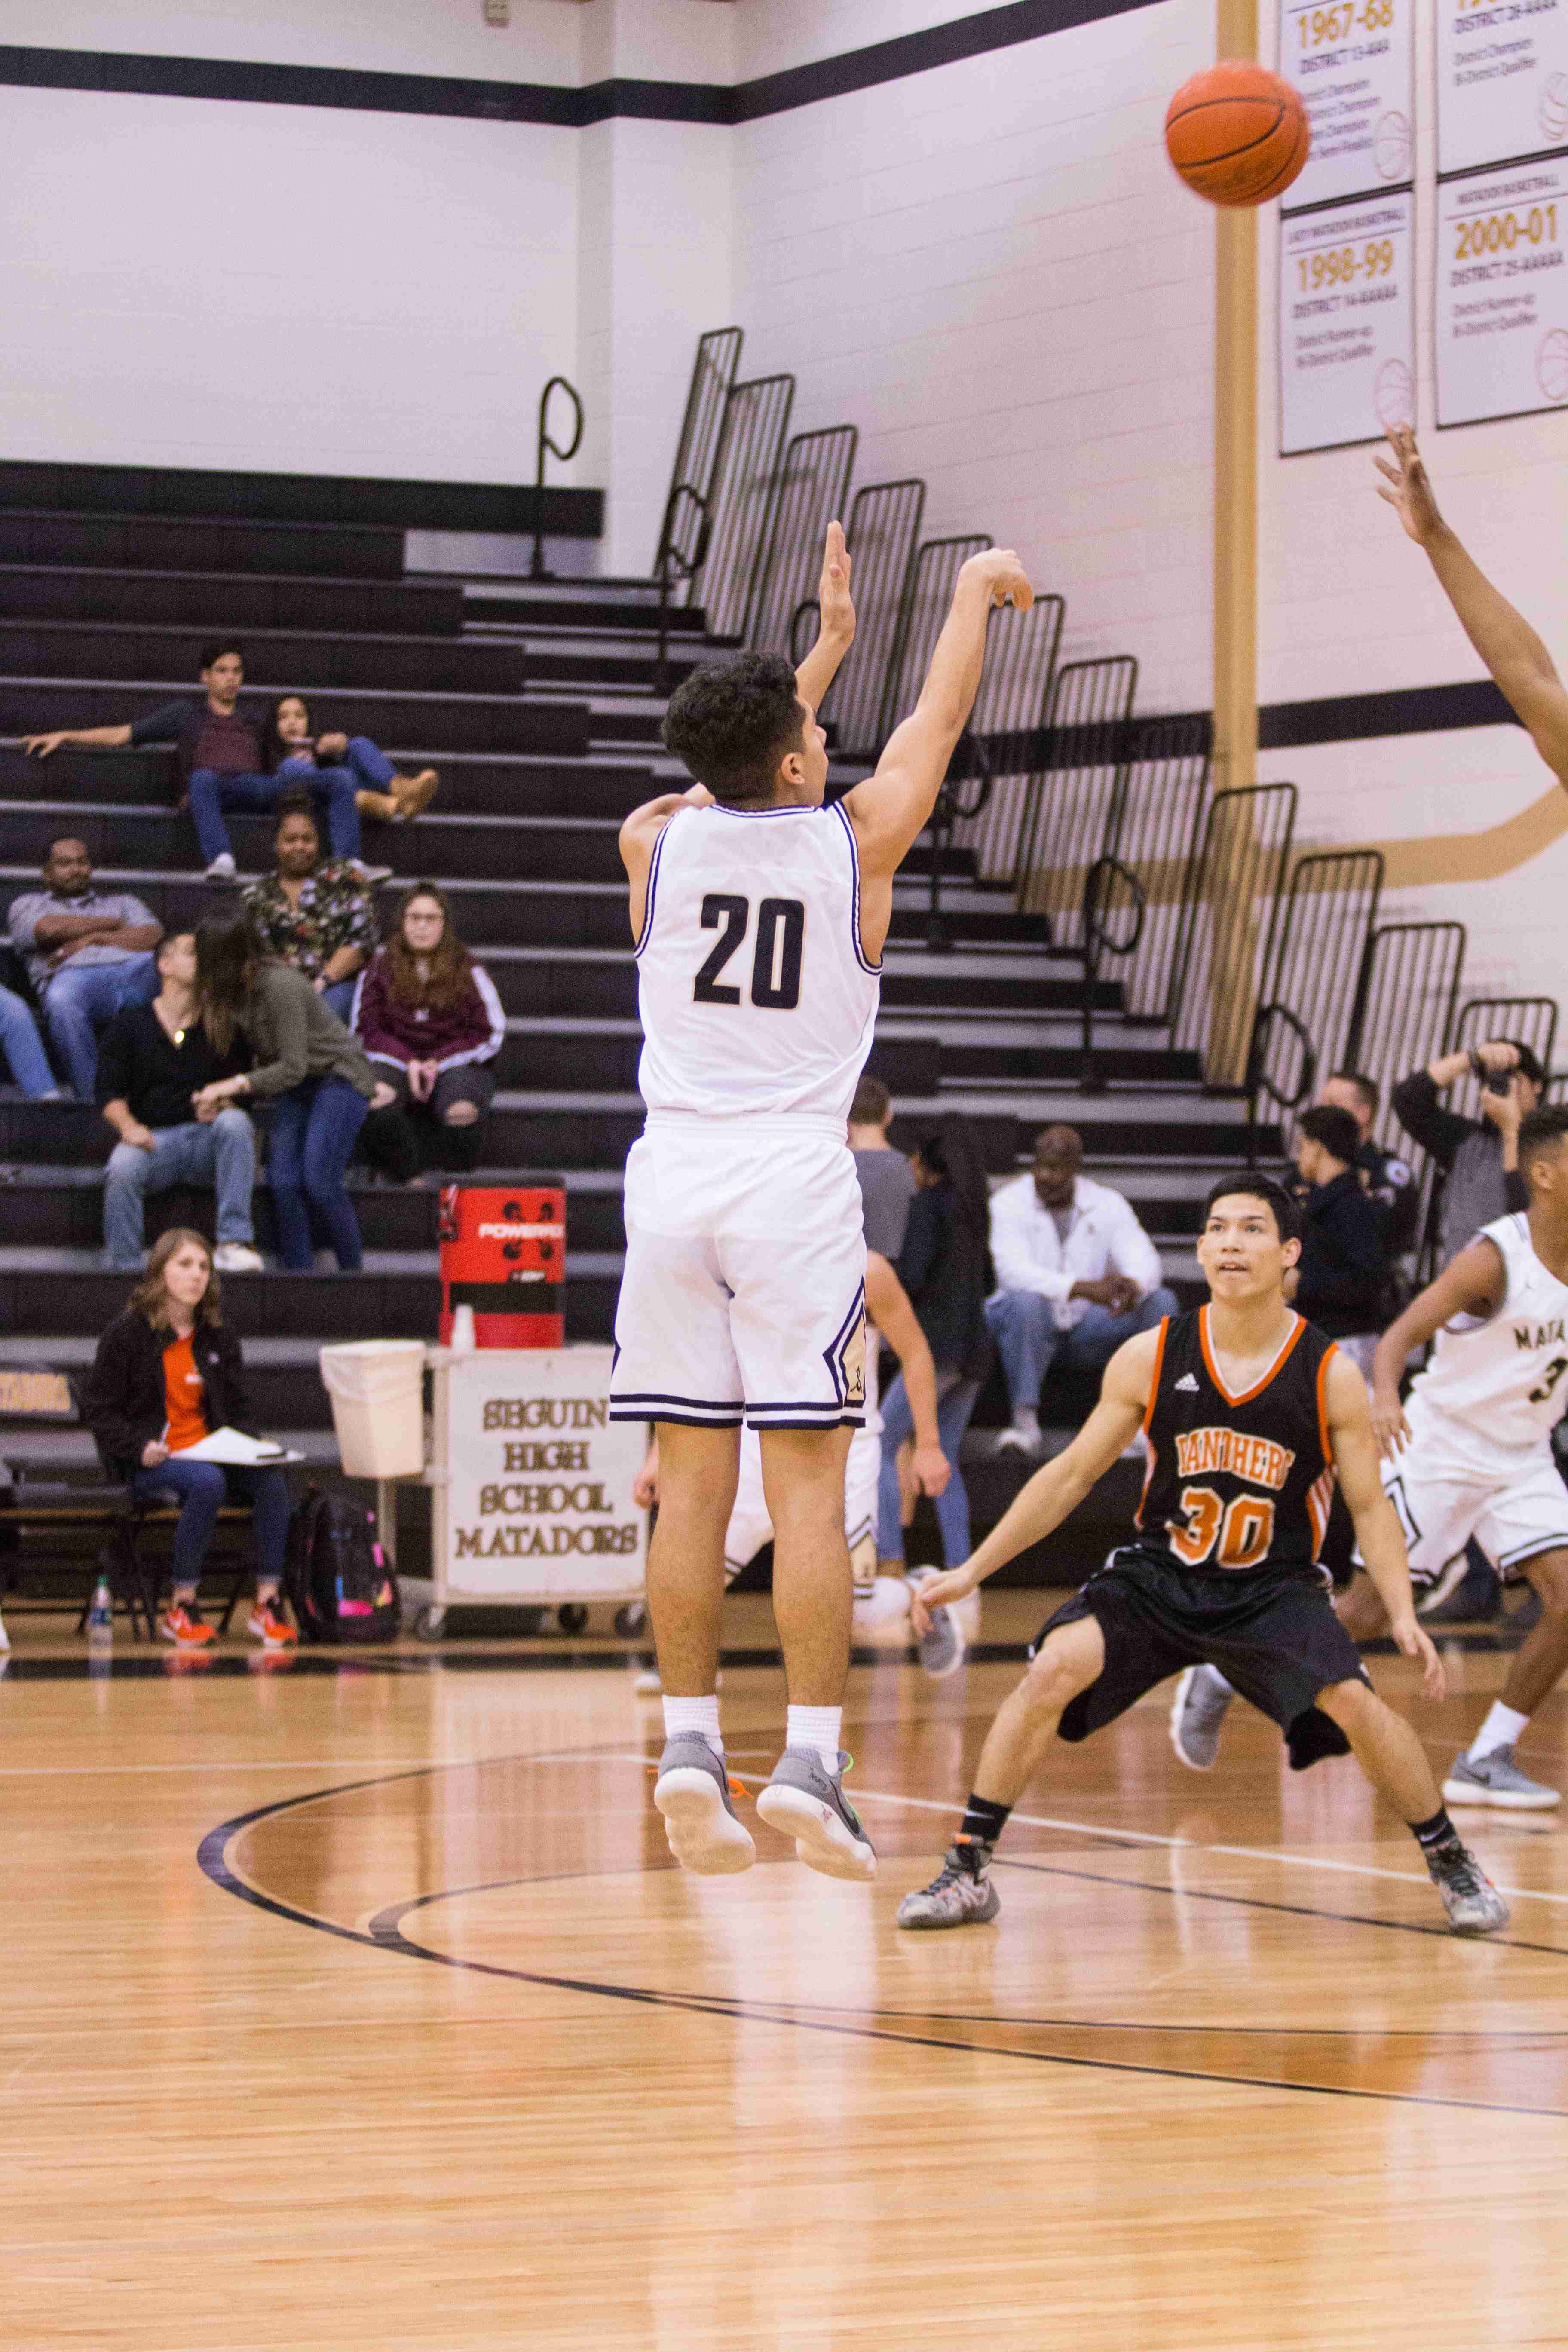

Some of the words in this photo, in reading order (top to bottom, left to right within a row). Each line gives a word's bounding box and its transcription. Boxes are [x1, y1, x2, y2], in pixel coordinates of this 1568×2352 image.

[1298, 0, 1394, 49] 1967-68
[1298, 48, 1347, 74] DISTRICT
[1454, 203, 1558, 260] 2000-01
[1298, 239, 1394, 292] 1998-99
[1450, 261, 1503, 288] DISTRICT
[1292, 294, 1342, 319] DISTRICT
[692, 893, 808, 1011] 20
[482, 1398, 608, 1431] SEGUIN
[502, 1440, 591, 1472] HIGH
[478, 1482, 613, 1516] SCHOOL
[454, 1523, 638, 1559] MATADORS
[1164, 1486, 1276, 1569] 30
